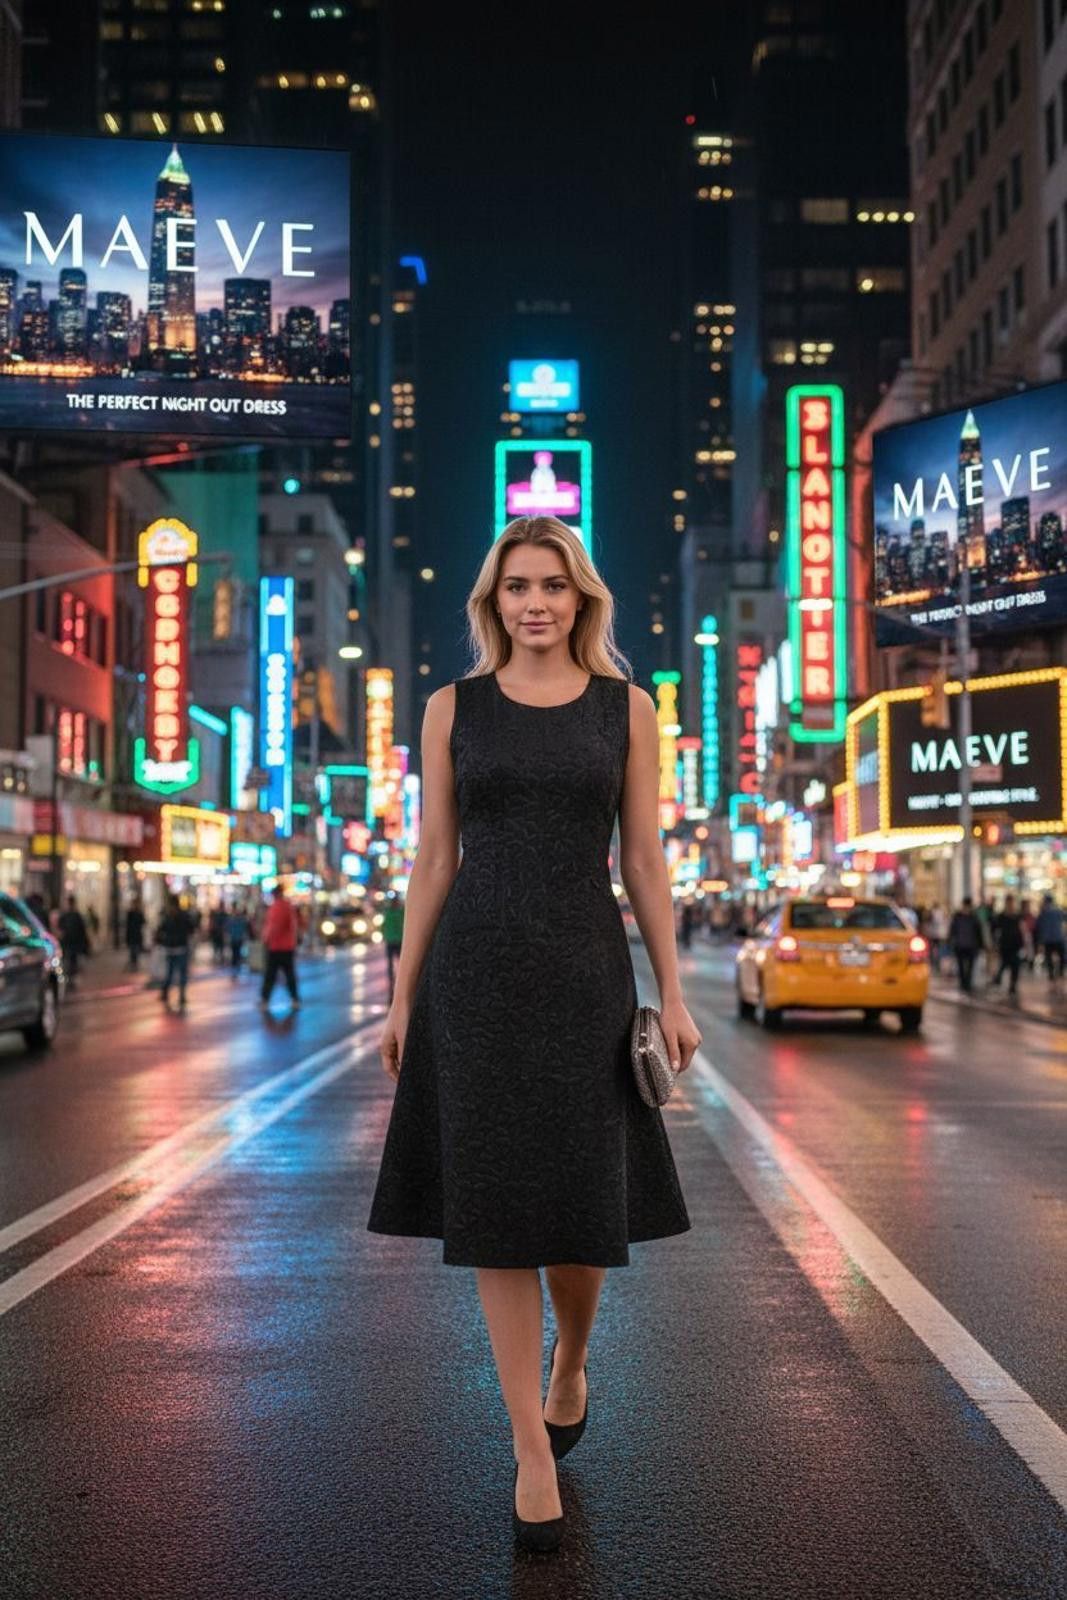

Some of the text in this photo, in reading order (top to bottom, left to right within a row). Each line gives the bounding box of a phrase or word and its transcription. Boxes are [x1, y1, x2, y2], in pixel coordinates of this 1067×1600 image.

[24, 211, 315, 277] MAEVE
[66, 394, 287, 415] THE PERFECT NIGHT OUT DRESS
[893, 447, 1051, 522] MAEVE
[911, 731, 1029, 773] MAEVE
